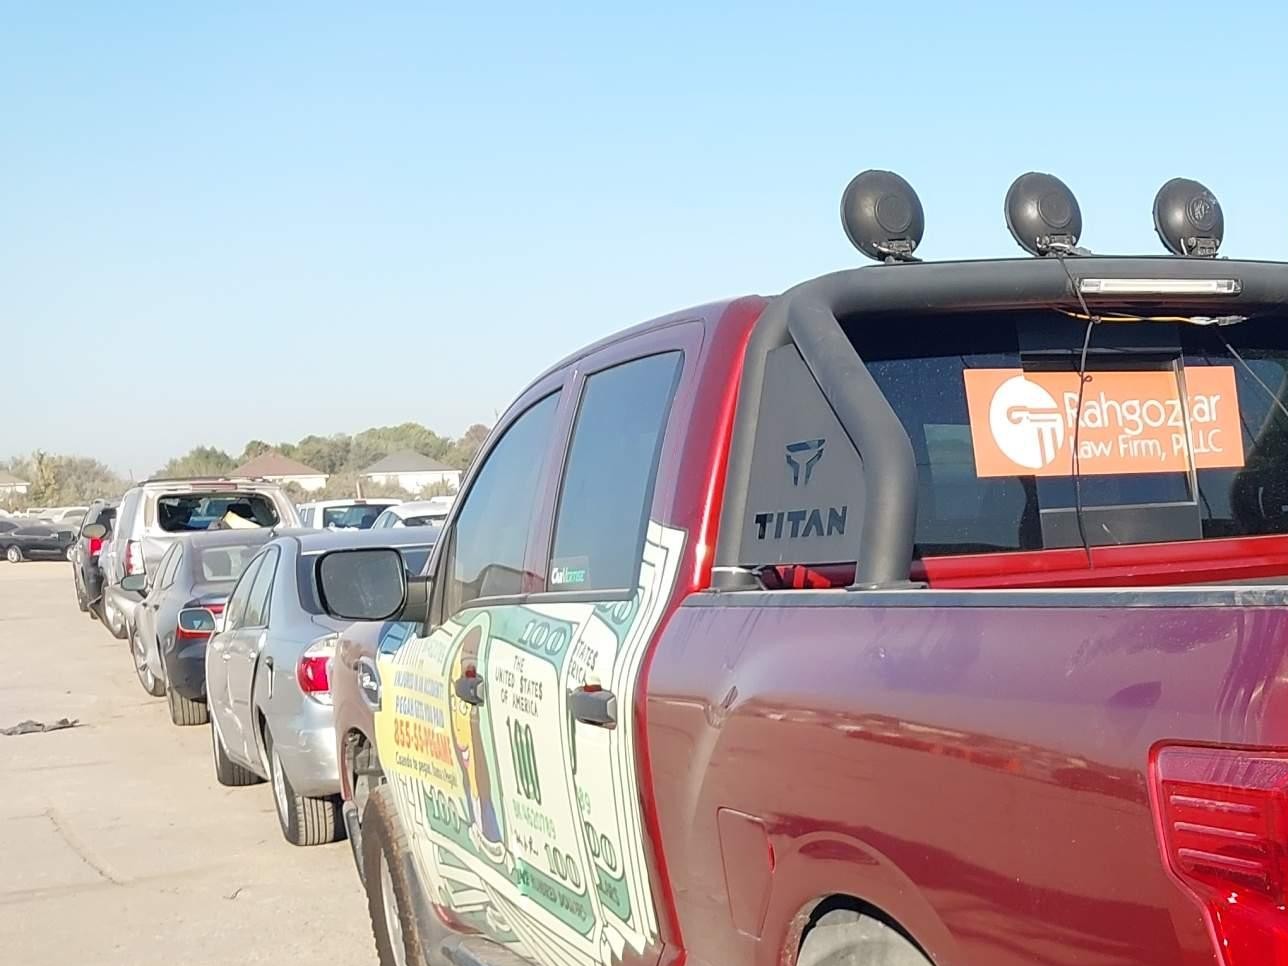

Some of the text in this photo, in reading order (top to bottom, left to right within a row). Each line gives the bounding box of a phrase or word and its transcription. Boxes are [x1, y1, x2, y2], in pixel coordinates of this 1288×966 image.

[755, 506, 848, 540] TITAN
[519, 619, 567, 656] 100
[495, 666, 515, 688] UNITED
[514, 655, 525, 673] THE
[501, 687, 539, 717] OF AMERICA
[506, 716, 541, 806] 100
